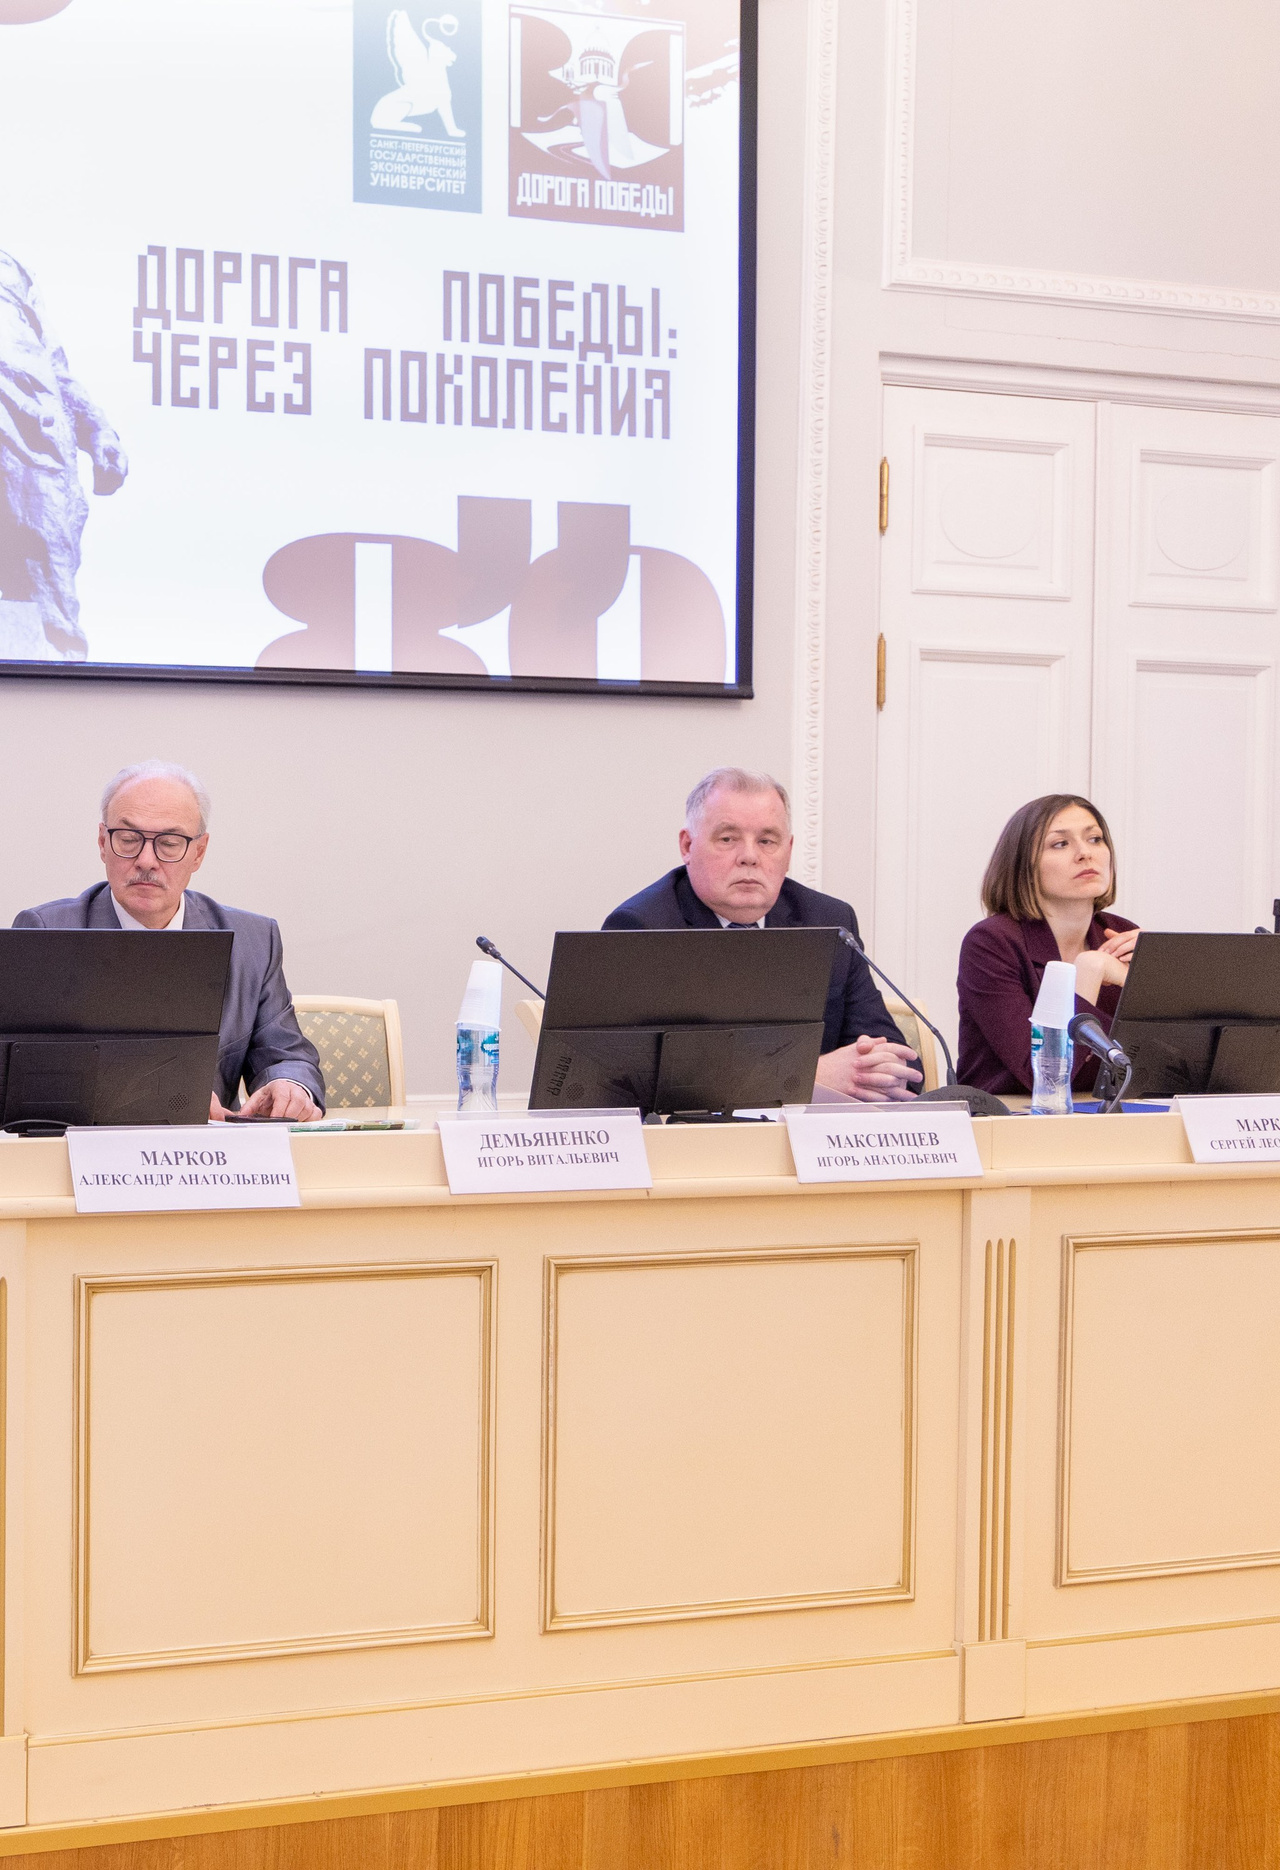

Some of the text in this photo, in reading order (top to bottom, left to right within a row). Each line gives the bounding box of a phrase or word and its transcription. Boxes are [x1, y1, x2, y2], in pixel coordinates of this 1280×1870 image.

[369, 139, 467, 157] САНКТ-ПЕТЕРБУРГСКИЙ
[369, 149, 467, 168] ГОСУДАРСТВЕННЫЙ
[369, 160, 467, 180] ЭКОНОМИЧЕСКИЙ
[369, 172, 466, 195] УНИВЕРСИТЕТ
[516, 172, 674, 218] ДОРОГА ПОБЕДЫ
[133, 245, 677, 363] ДОРОГА ПОБЕДЫ:
[133, 330, 670, 439] ЧЕРЕЗ ПОКОЛЕНИЯ
[480, 1129, 610, 1151] ДЕМЬЯНЕНКО
[826, 1132, 940, 1149] МАКСИМЦЕВ
[1210, 1137, 1255, 1150] СЕРГЕЙ
[140, 1151, 227, 1166] МАРКОВ
[477, 1151, 619, 1168] ИГОРЬ ВИТАЛЬЕВИЧ
[816, 1152, 958, 1167] ИГОРЬ АНАТОЛЬЕВИЧ
[79, 1173, 291, 1187] АЛЕКСАНДР АНАТОЛЬЕВИЧ
